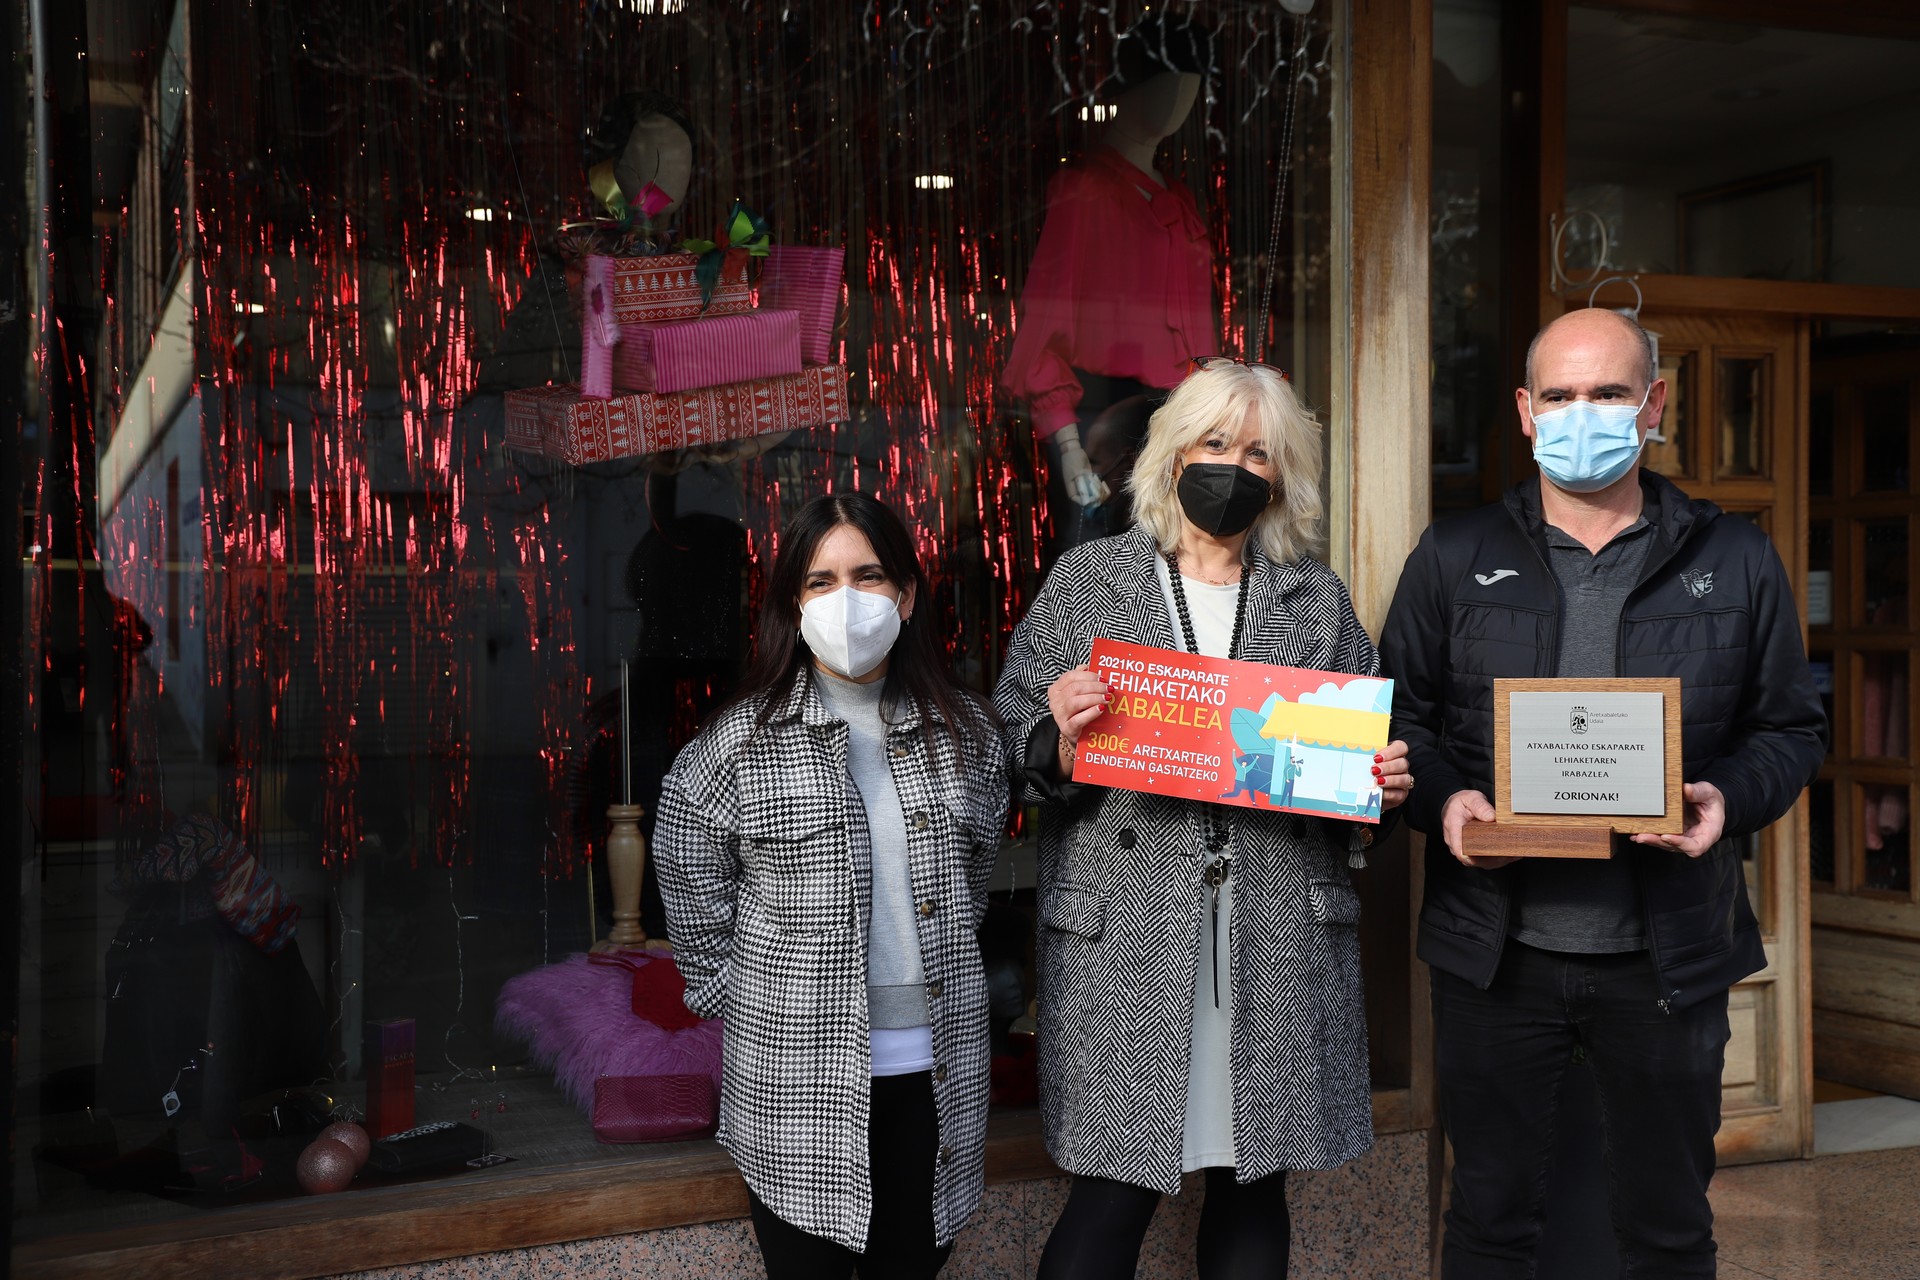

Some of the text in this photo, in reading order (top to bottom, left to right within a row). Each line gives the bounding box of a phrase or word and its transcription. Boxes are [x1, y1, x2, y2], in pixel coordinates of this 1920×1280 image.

[1098, 655, 1230, 686] 2021KO ESKAPARATE
[1107, 692, 1223, 731] RABAZLEA
[1087, 731, 1221, 767] 300€ ARETXARTEKO
[1526, 742, 1646, 751] ATXABALTAKO ESKAPARATE
[1085, 752, 1219, 782] DENDETAN GASTATZEKO
[1554, 756, 1617, 764] LEHIAKETAREN
[1561, 770, 1609, 778] IRABAZLEA
[1553, 791, 1619, 802] ZORIONAK!
